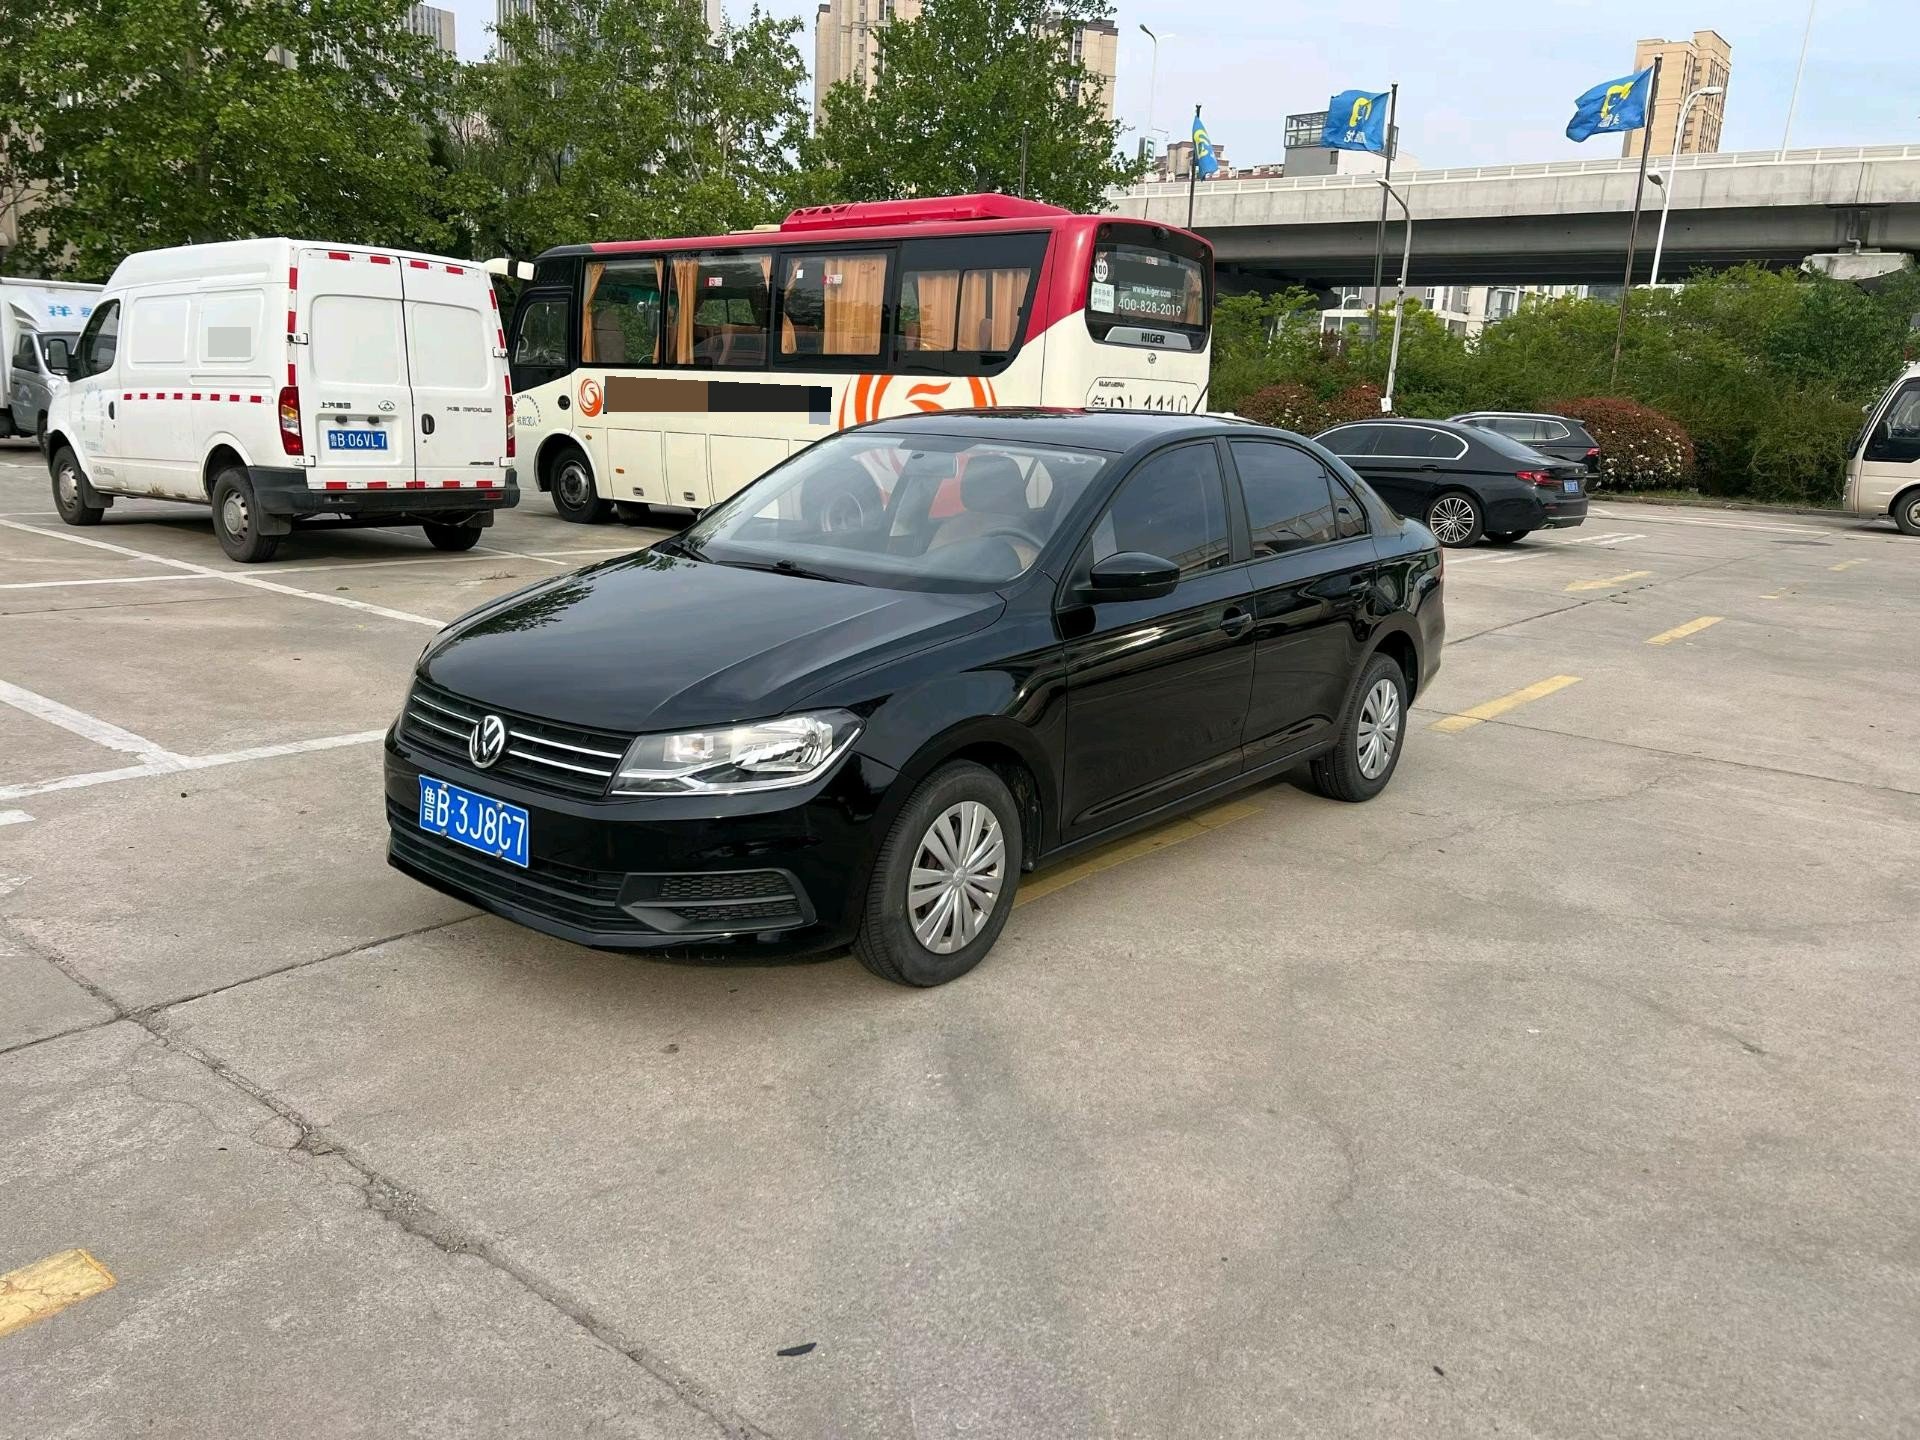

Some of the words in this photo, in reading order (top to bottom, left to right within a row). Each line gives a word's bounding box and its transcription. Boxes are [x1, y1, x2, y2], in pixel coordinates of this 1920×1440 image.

[1095, 264, 1107, 275] 100
[1132, 285, 1171, 298] www.higer.com
[1118, 298, 1182, 317] 400-828-2019
[1141, 332, 1165, 345] HIGER
